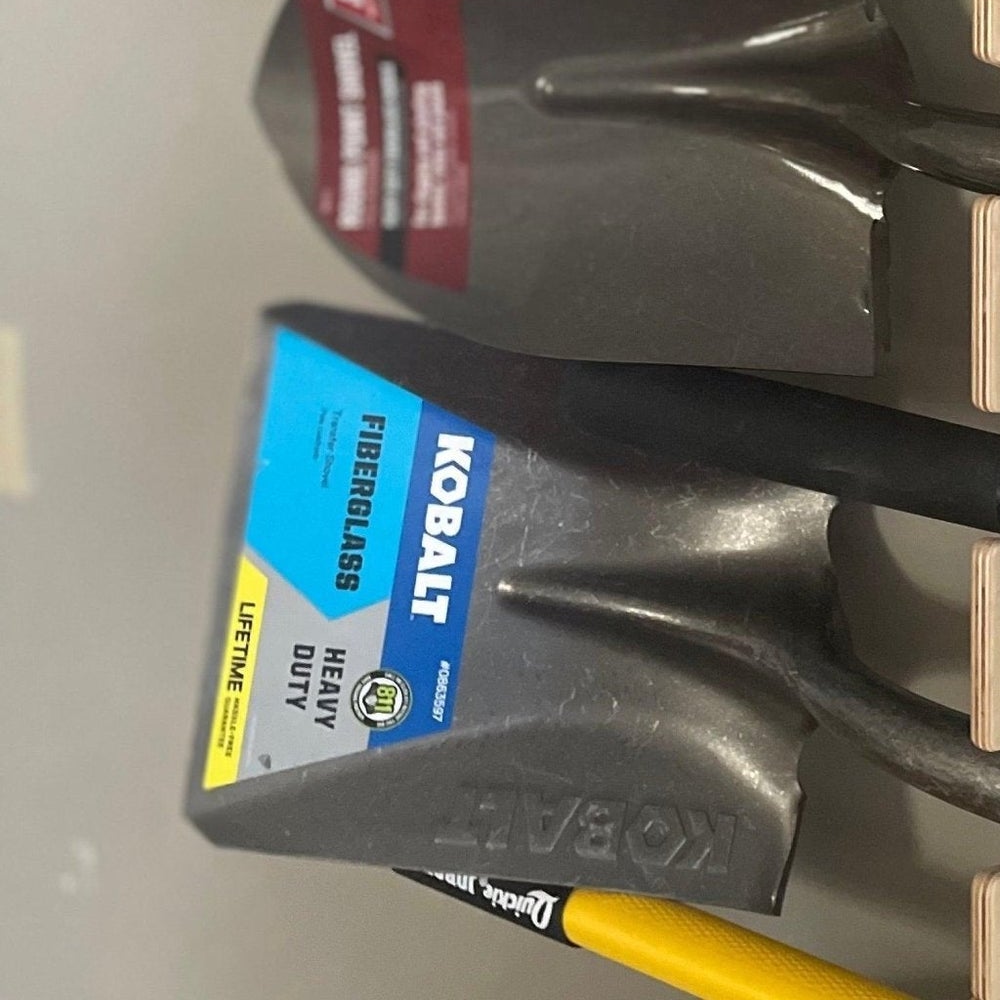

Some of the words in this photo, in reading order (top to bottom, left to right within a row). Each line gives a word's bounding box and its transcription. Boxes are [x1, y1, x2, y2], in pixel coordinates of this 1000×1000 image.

[335, 413, 387, 593] FIBERGLASS
[412, 432, 475, 625] KOBALT
[227, 601, 256, 693] LIFETIME
[285, 643, 316, 712] DUTY
[314, 646, 347, 731] HEAVY
[436, 660, 451, 724] #0863597
[433, 797, 738, 874] KOBALT
[482, 889, 560, 930] Quickie
